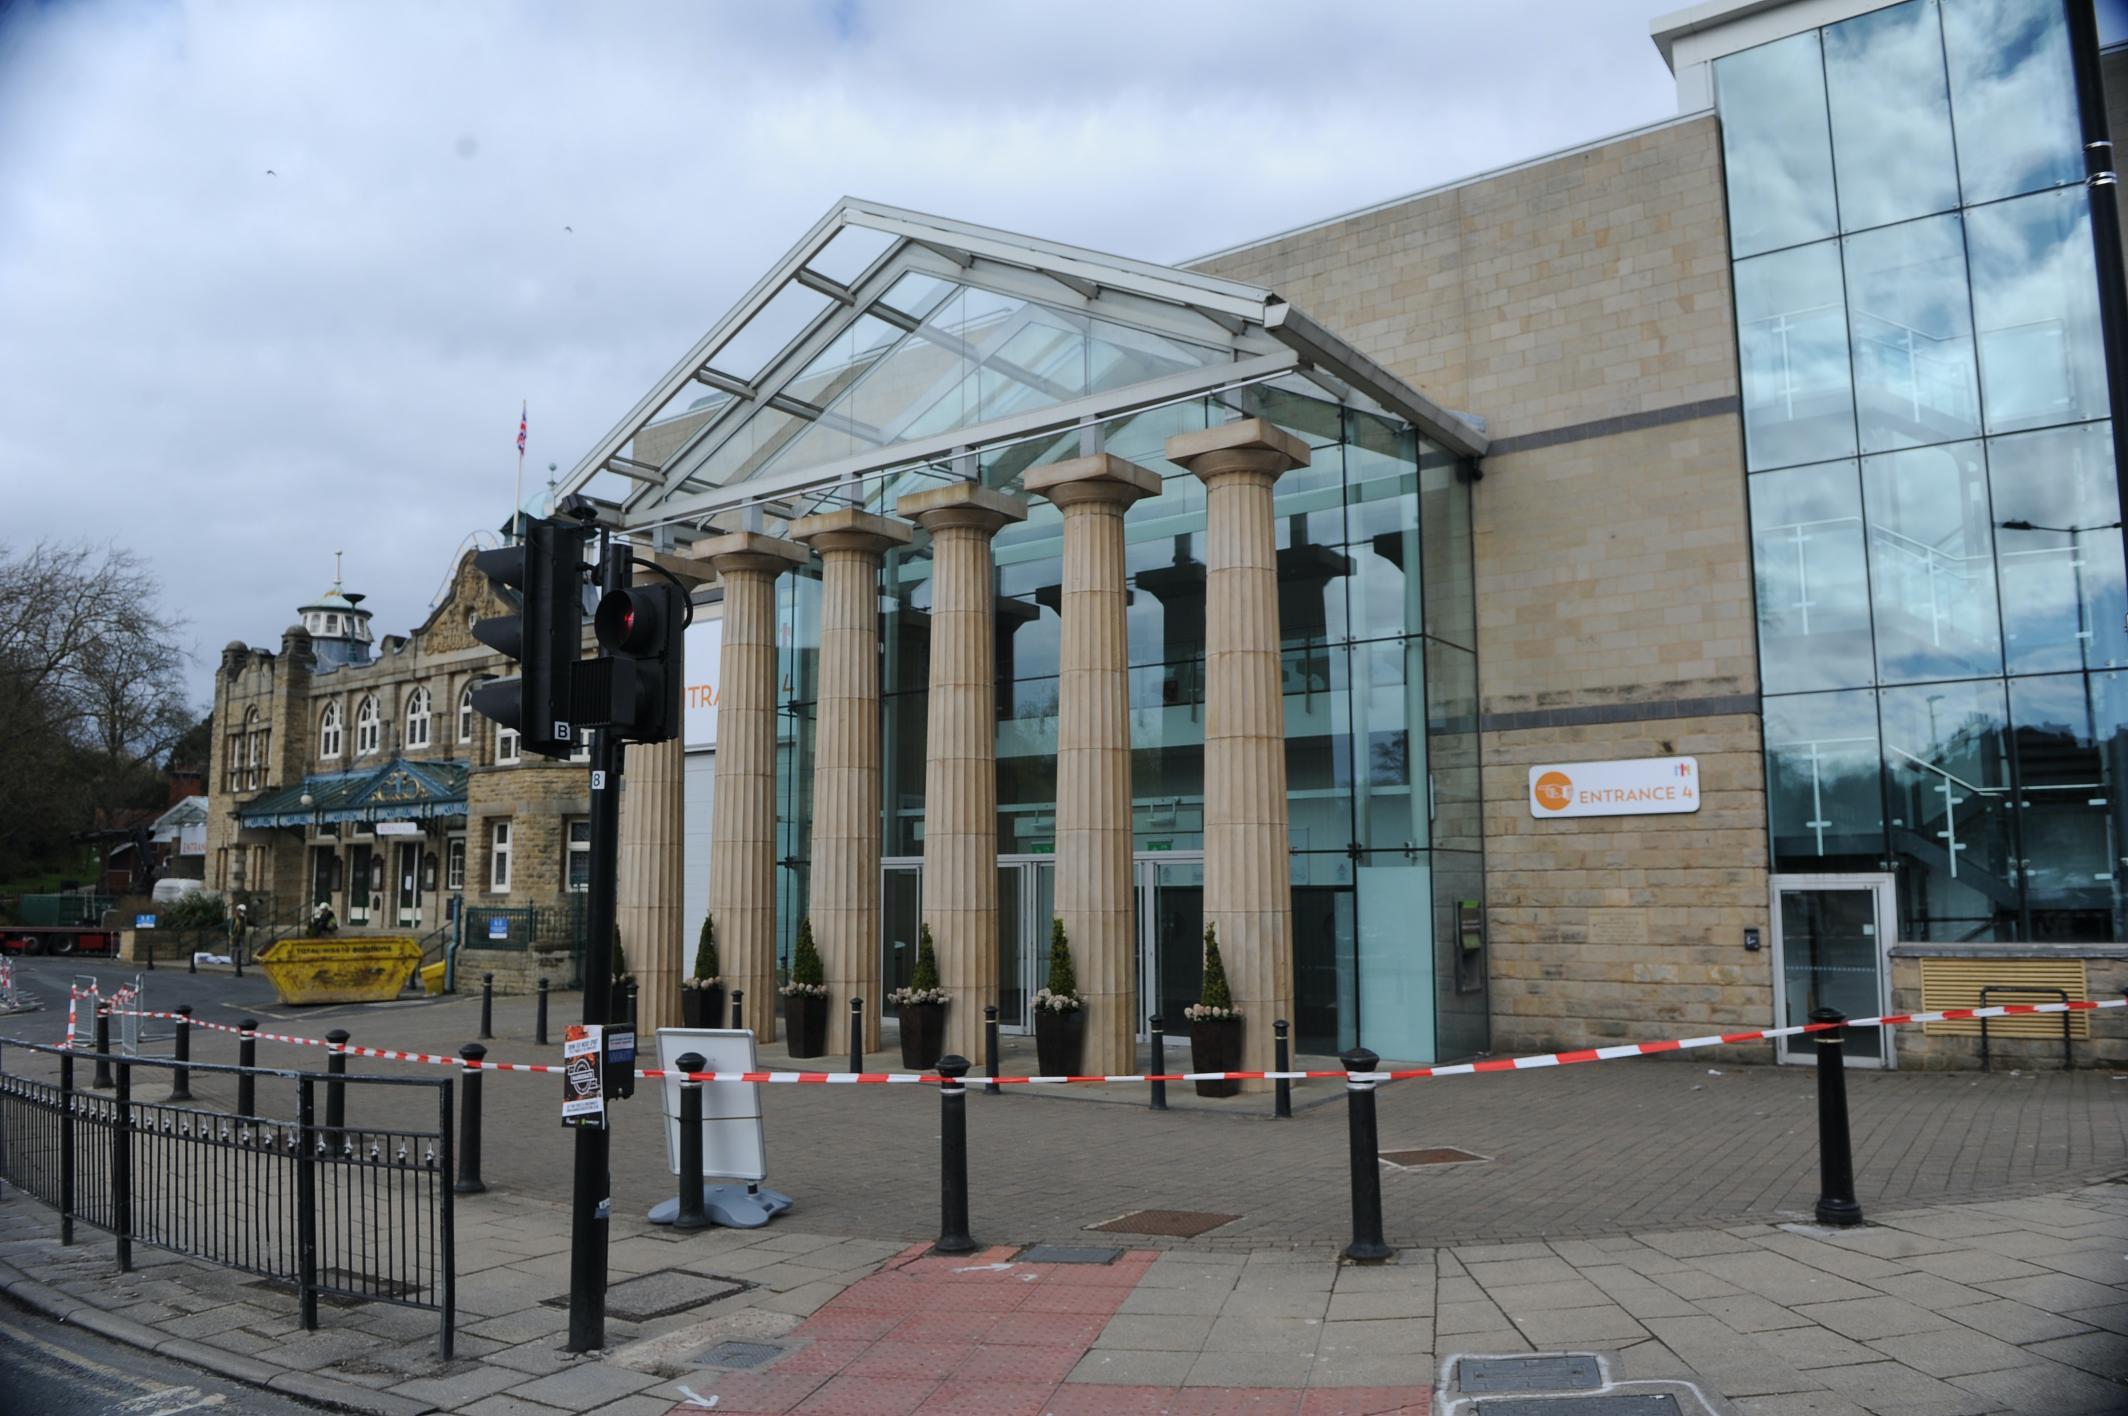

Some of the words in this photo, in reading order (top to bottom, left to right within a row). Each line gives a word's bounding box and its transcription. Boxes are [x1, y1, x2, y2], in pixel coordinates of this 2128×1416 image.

[558, 725, 568, 738] B
[593, 773, 601, 787] 8
[1579, 786, 1675, 804] ENTRANCE
[1682, 786, 1693, 799] 4
